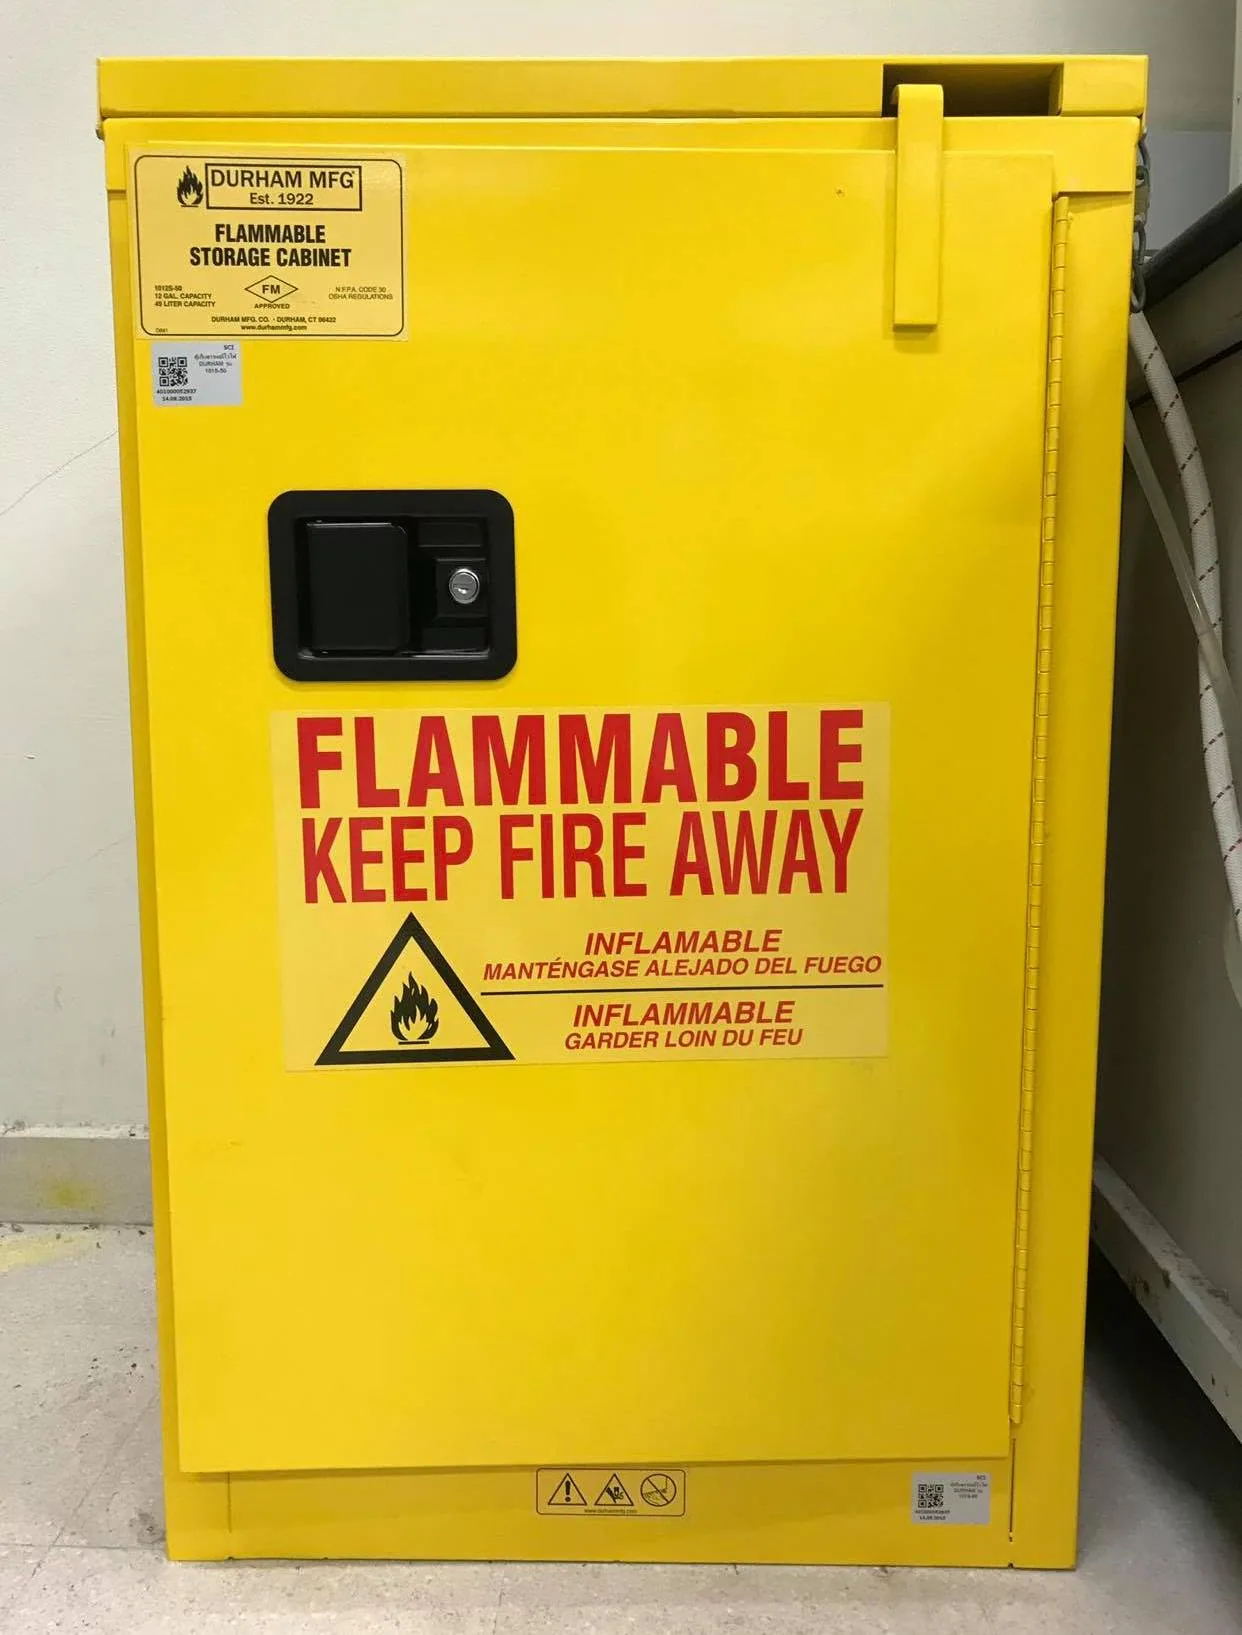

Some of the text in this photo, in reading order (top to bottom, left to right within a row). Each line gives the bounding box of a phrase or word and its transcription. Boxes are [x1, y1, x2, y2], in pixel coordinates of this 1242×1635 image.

[211, 169, 355, 189] DURHAM MFG
[249, 192, 314, 206] Est. 1922
[215, 224, 326, 244] FLAMMABLE
[190, 247, 352, 267] STORAGE CABINET
[262, 284, 281, 294] FM
[296, 709, 865, 809] FLAMMABLE
[302, 808, 864, 904] KEEP FIRE AWAY
[584, 929, 783, 956] INFLAMABLE
[482, 955, 884, 981] MANTÉNGASE ALEJADO DEL FUEGO
[572, 1000, 797, 1028] INFLAMMABLE
[563, 1028, 805, 1050] GARDER LOIN DU FEU
